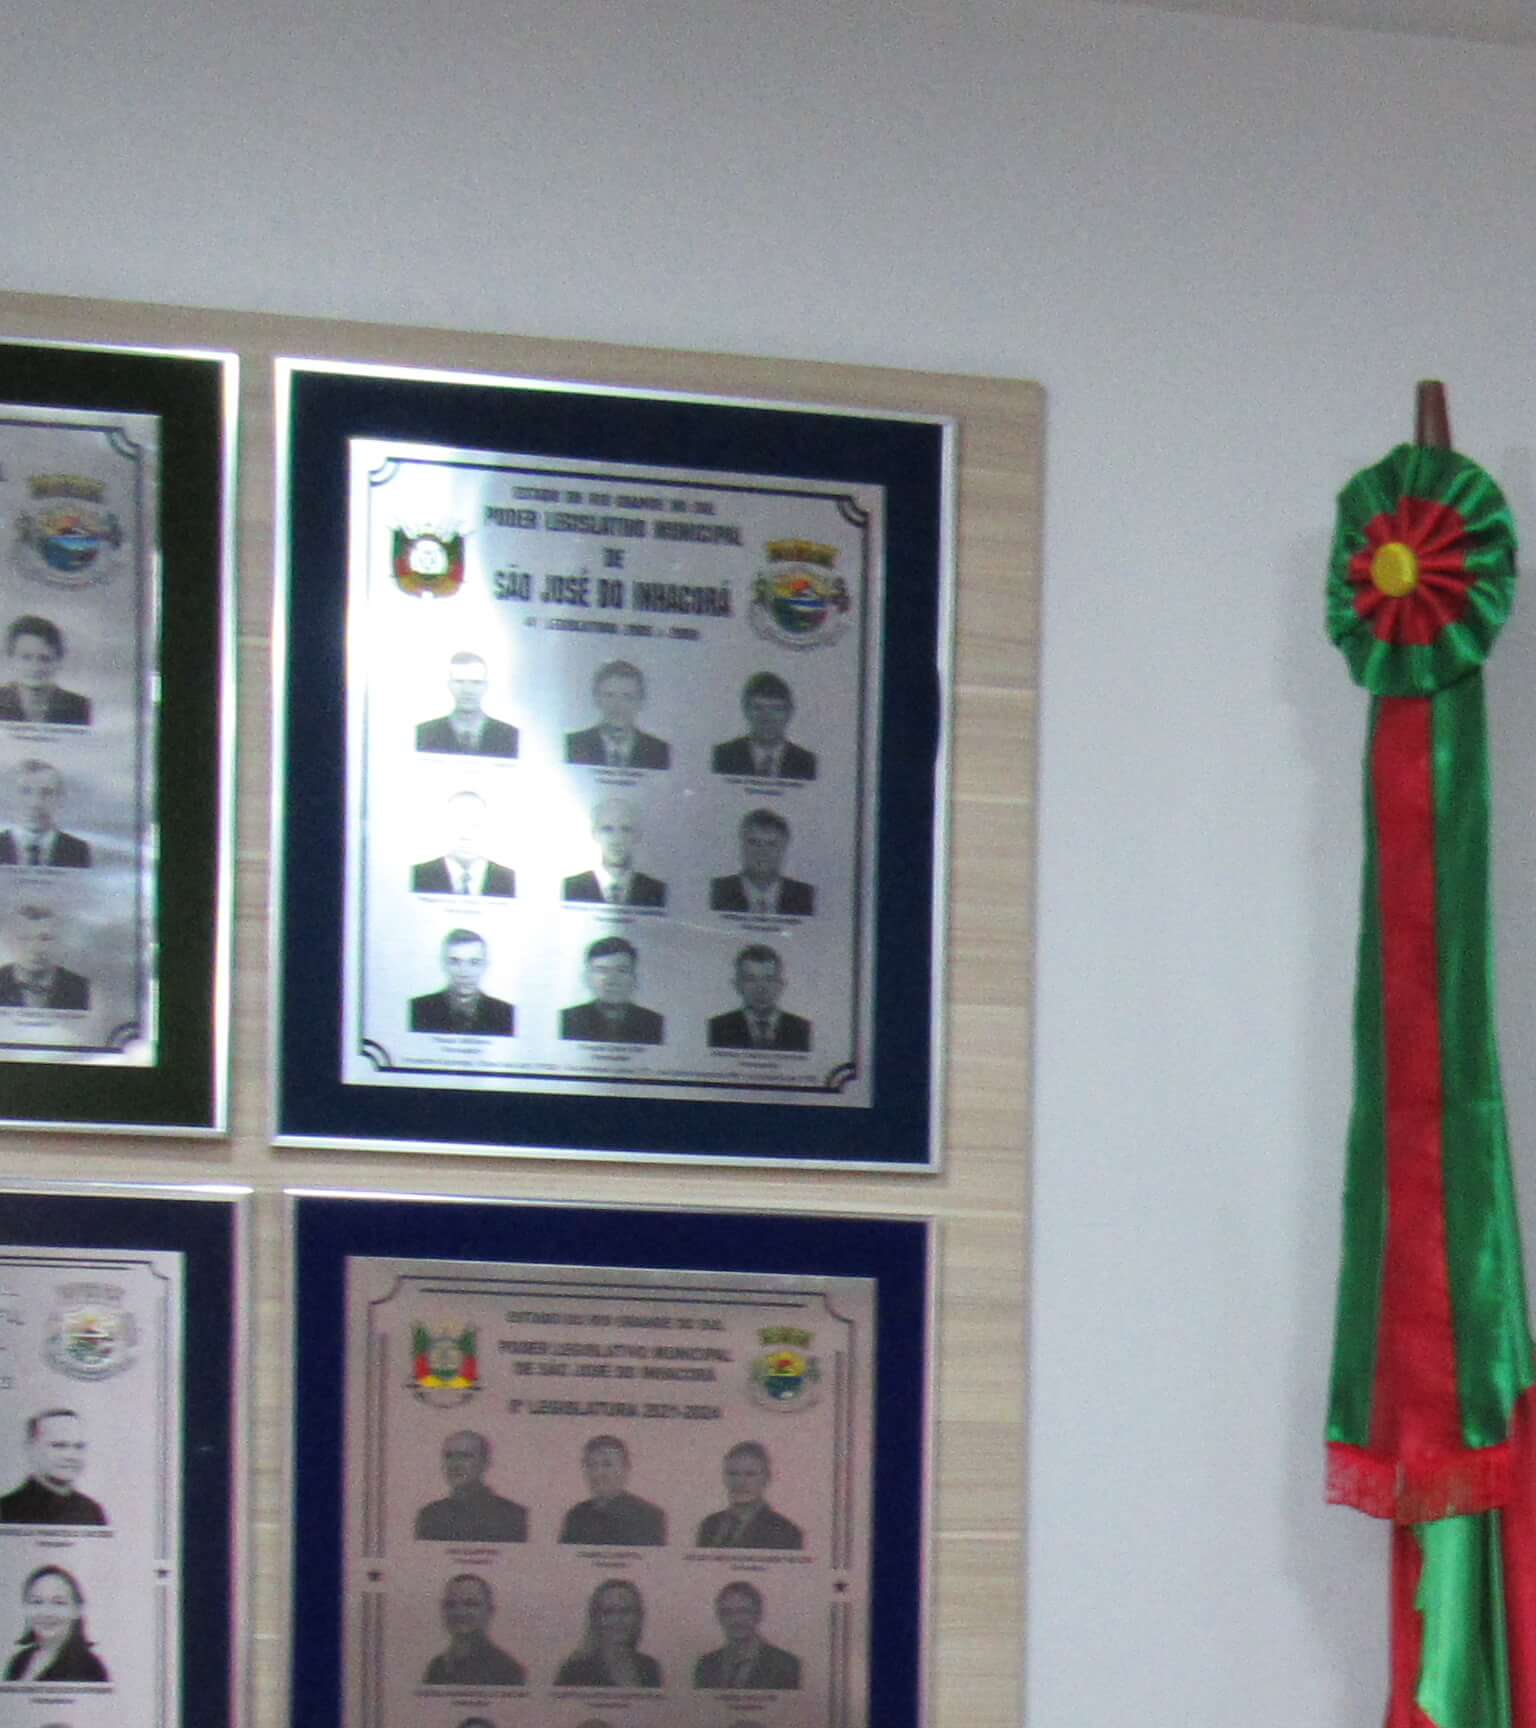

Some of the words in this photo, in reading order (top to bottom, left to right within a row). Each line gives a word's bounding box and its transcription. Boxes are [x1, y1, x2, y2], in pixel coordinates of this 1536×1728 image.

[484, 506, 537, 529] PODER
[545, 510, 646, 538] LEGISLATIVO
[493, 563, 532, 602] SÃO
[540, 567, 591, 608] JOSÉ
